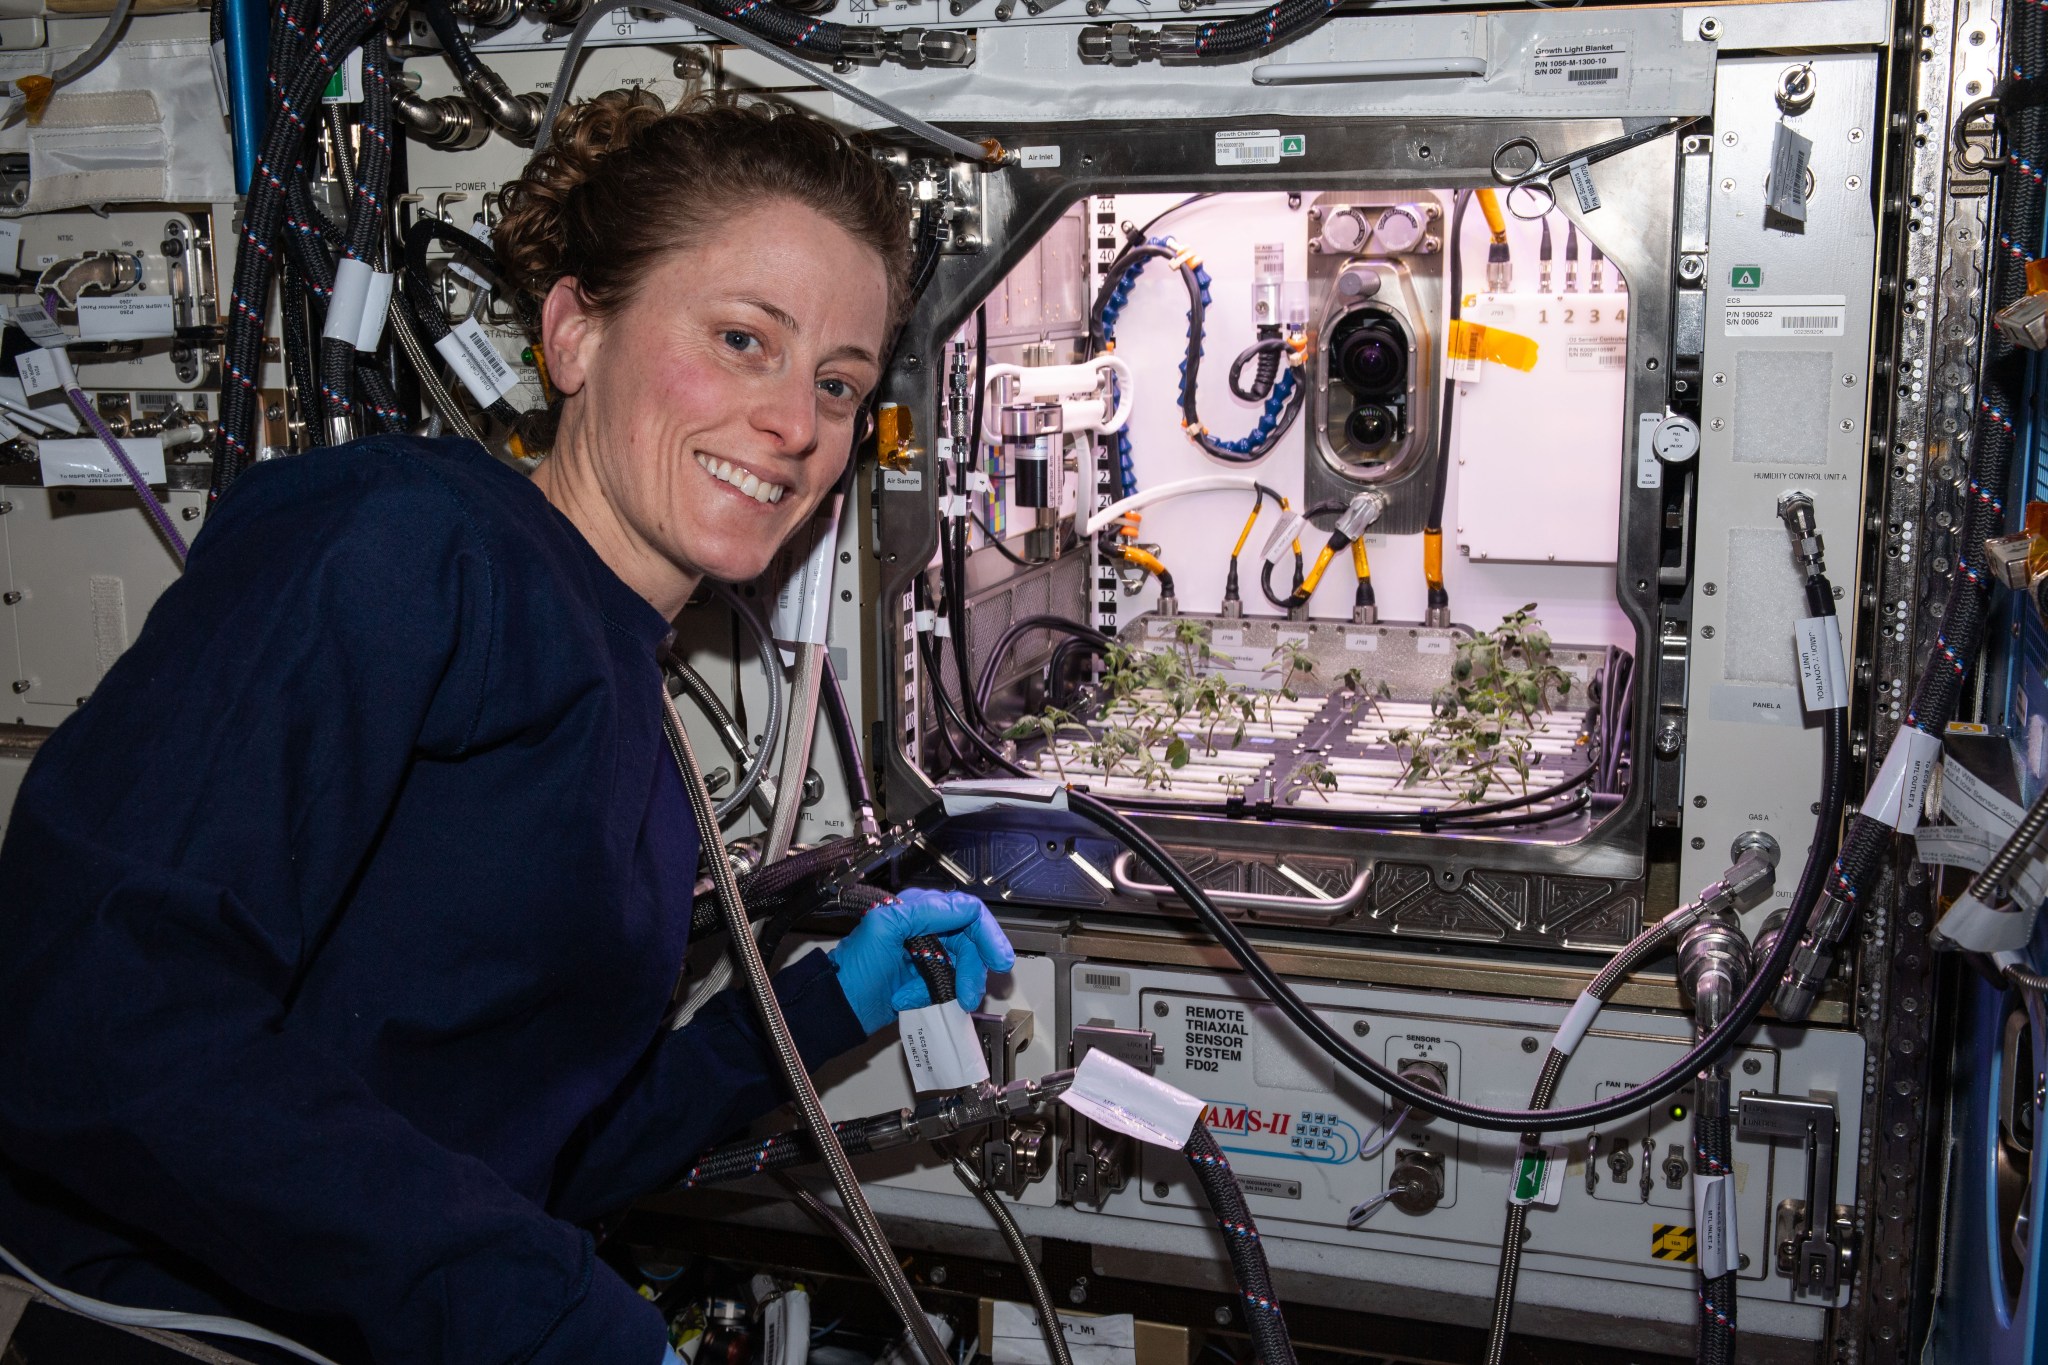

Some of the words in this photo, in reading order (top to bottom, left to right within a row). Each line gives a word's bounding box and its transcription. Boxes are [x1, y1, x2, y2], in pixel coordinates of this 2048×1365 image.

[858, 13, 870, 24] J1
[618, 24, 632, 34] G1
[1564, 46, 1583, 54] Light
[1550, 58, 1606, 67] 1056-M-1300-10
[455, 182, 486, 191] POWER
[1574, 172, 1586, 195] Scissors
[1099, 200, 1113, 210] 44
[1581, 195, 1590, 210] Small
[1099, 226, 1114, 236] 42
[1100, 250, 1114, 261] 40
[1539, 310, 1548, 323] 1
[1564, 309, 1574, 323] 2
[1590, 309, 1600, 323] 3
[1615, 309, 1626, 323] 4
[485, 330, 519, 338] STATUS
[1101, 568, 1115, 578] 14
[904, 594, 912, 607] 18
[1101, 591, 1115, 601] 12
[1101, 615, 1115, 625] 10
[906, 625, 913, 637] 16
[906, 655, 913, 668] 14
[1802, 652, 1811, 669] UNIT
[1814, 663, 1824, 701] CONTROL
[907, 686, 914, 698] 12
[907, 714, 914, 726] 10
[909, 746, 913, 758] 8
[1910, 776, 1918, 805] OUTLET
[1954, 776, 1972, 792] Flow
[1973, 789, 2000, 811] Sensor
[1186, 1006, 1244, 1022] REMOTE
[1186, 1019, 1248, 1036] TRIAXIAL
[1186, 1032, 1243, 1048] SENSOR
[1407, 1035, 1441, 1043] SENSORS
[911, 1046, 920, 1062] INLET
[1186, 1046, 1241, 1061] SYSTEM
[1186, 1059, 1219, 1072] FD02
